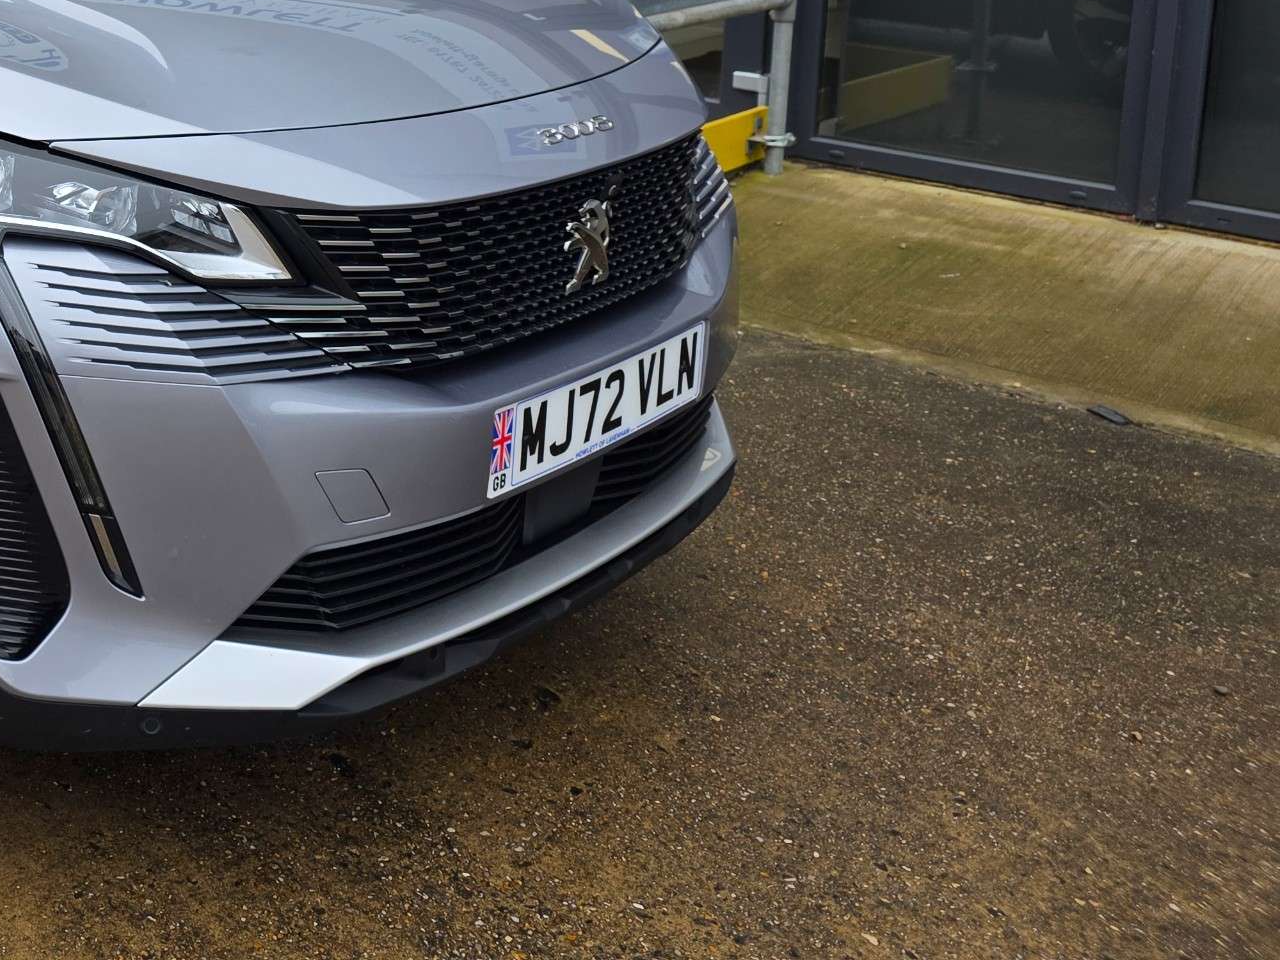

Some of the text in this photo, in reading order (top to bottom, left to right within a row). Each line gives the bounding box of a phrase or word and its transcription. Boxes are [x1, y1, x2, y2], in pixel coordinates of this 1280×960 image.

[536, 114, 616, 146] 3008
[519, 332, 698, 472] MJ72 VLN
[492, 473, 506, 492] GB
